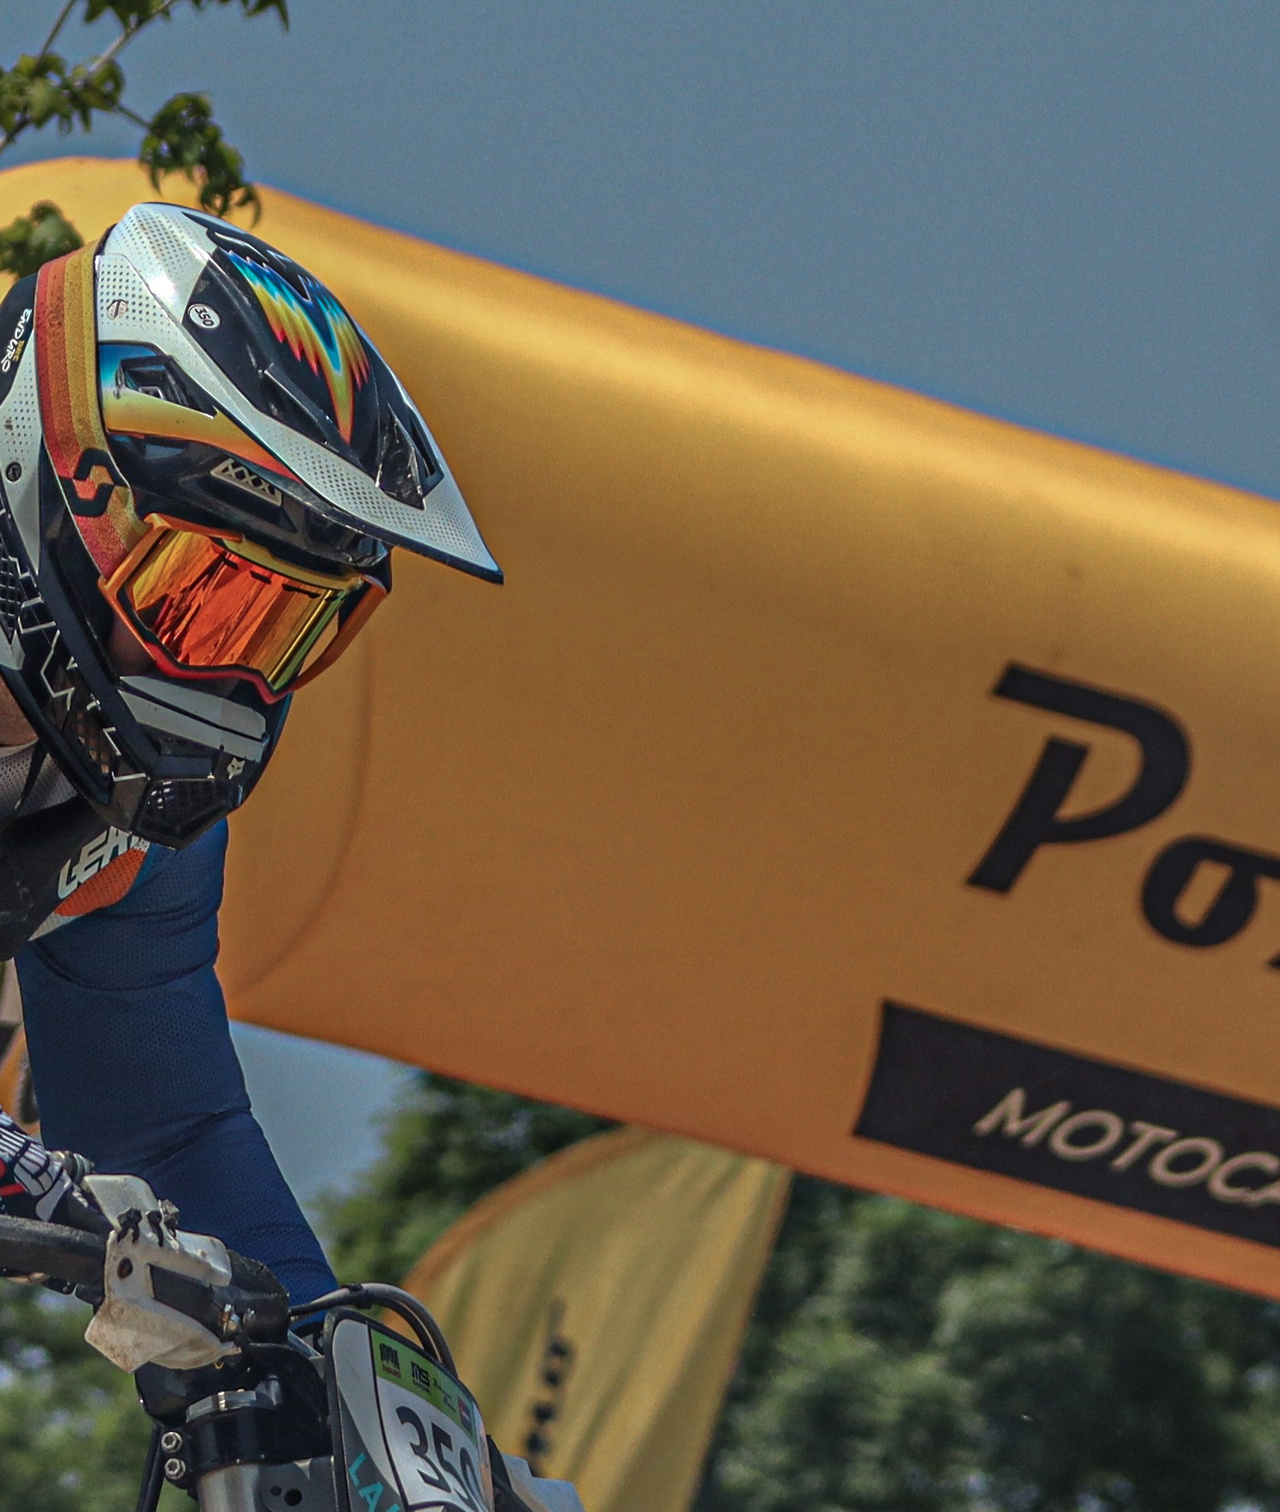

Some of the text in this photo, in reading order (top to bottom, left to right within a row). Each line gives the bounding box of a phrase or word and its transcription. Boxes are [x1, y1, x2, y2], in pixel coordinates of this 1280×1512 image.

[194, 307, 216, 327] 350
[974, 1089, 1280, 1209] MOTOC
[395, 1405, 484, 1512] 350
